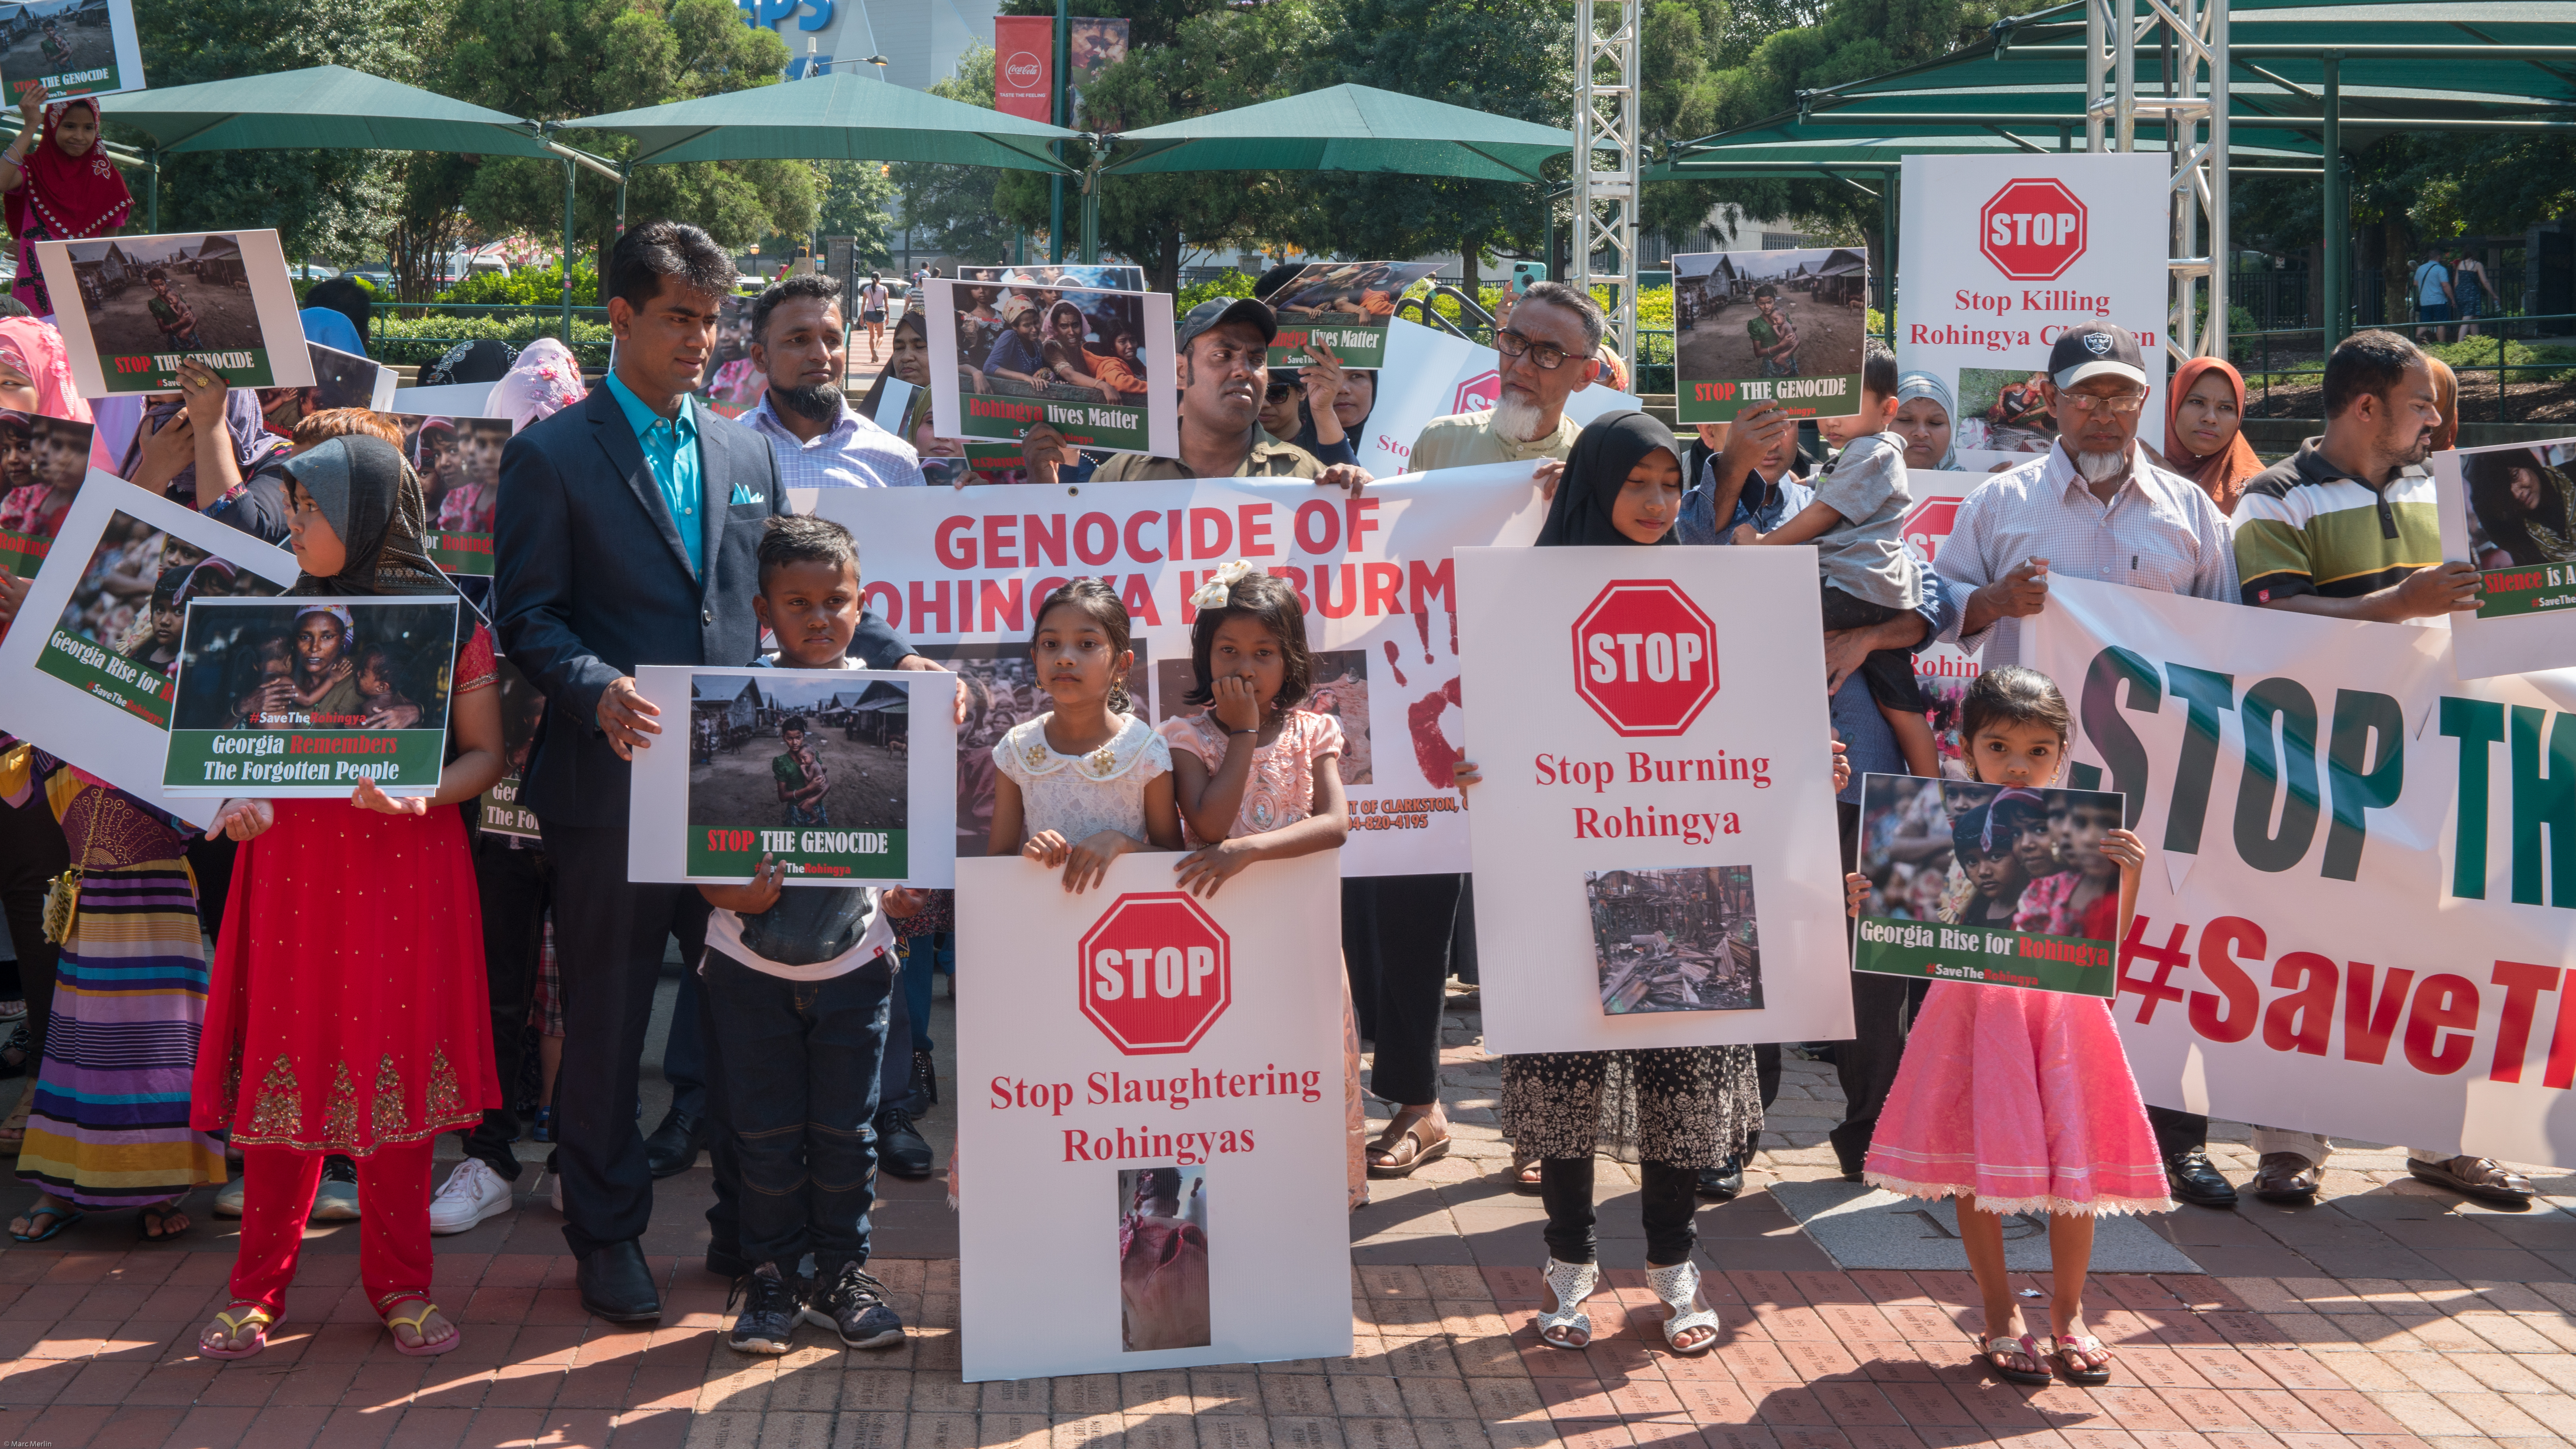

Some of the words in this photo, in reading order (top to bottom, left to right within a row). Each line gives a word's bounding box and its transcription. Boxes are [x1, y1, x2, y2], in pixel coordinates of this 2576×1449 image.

[41, 76, 60, 87] THE
[62, 68, 109, 85] GENOCIDE
[1008, 64, 1038, 74] Coca-Cola
[1991, 213, 2076, 246] STOP
[1955, 289, 2012, 316] Stop
[2021, 290, 2110, 317] Killing
[1341, 330, 1379, 348] Matter
[1909, 324, 2031, 351] Rohingya
[115, 356, 151, 373] STOP
[154, 355, 182, 371] THE
[1695, 383, 1736, 402] STOP
[1740, 382, 1772, 400] THE
[1777, 378, 1847, 399] GENOCIDE
[970, 398, 1043, 422] Rohingya
[1047, 405, 1084, 425] lives
[1088, 408, 1139, 430] Matter
[935, 502, 1276, 570] GENOCIDE
[1294, 498, 1381, 555] OF
[2485, 572, 2543, 594] Silence
[2546, 567, 2561, 586] is
[51, 630, 106, 669] Georgia
[105, 656, 137, 683] Rise
[136, 671, 161, 694] for
[1589, 632, 1703, 684] STOP
[85, 680, 164, 725] #SaveTheRohingya
[249, 712, 366, 725] #SaveTheRohingya
[212, 735, 284, 757] Georgia
[290, 735, 397, 754] Remembers
[204, 761, 236, 780] The
[241, 761, 330, 782] Forgotten
[335, 761, 399, 781] People
[1534, 752, 1615, 793] Stop
[1627, 749, 1771, 789] Burning
[2070, 645, 2405, 883] STOP
[2440, 696, 2576, 910] TH
[487, 805, 513, 826] The
[1361, 799, 1377, 814] OF
[1381, 797, 1459, 813] CLARKSTON,
[1573, 805, 1742, 845] Rohingya
[708, 830, 755, 852] STOP
[760, 831, 795, 852] THE
[801, 831, 888, 853] GENOCIDE
[1860, 921, 1934, 948] Georgia
[1939, 928, 1980, 952] Rise
[1984, 933, 2013, 955] for
[2018, 937, 2109, 967] Rohingya
[1095, 947, 1215, 1001] STOP
[1926, 963, 2039, 987] #SaveTheRohingya
[2111, 915, 2576, 1090] #SaveT
[990, 1076, 1074, 1116] Stop
[1087, 1063, 1322, 1110] Slaughtering
[1061, 1125, 1255, 1166] Rohingyas
